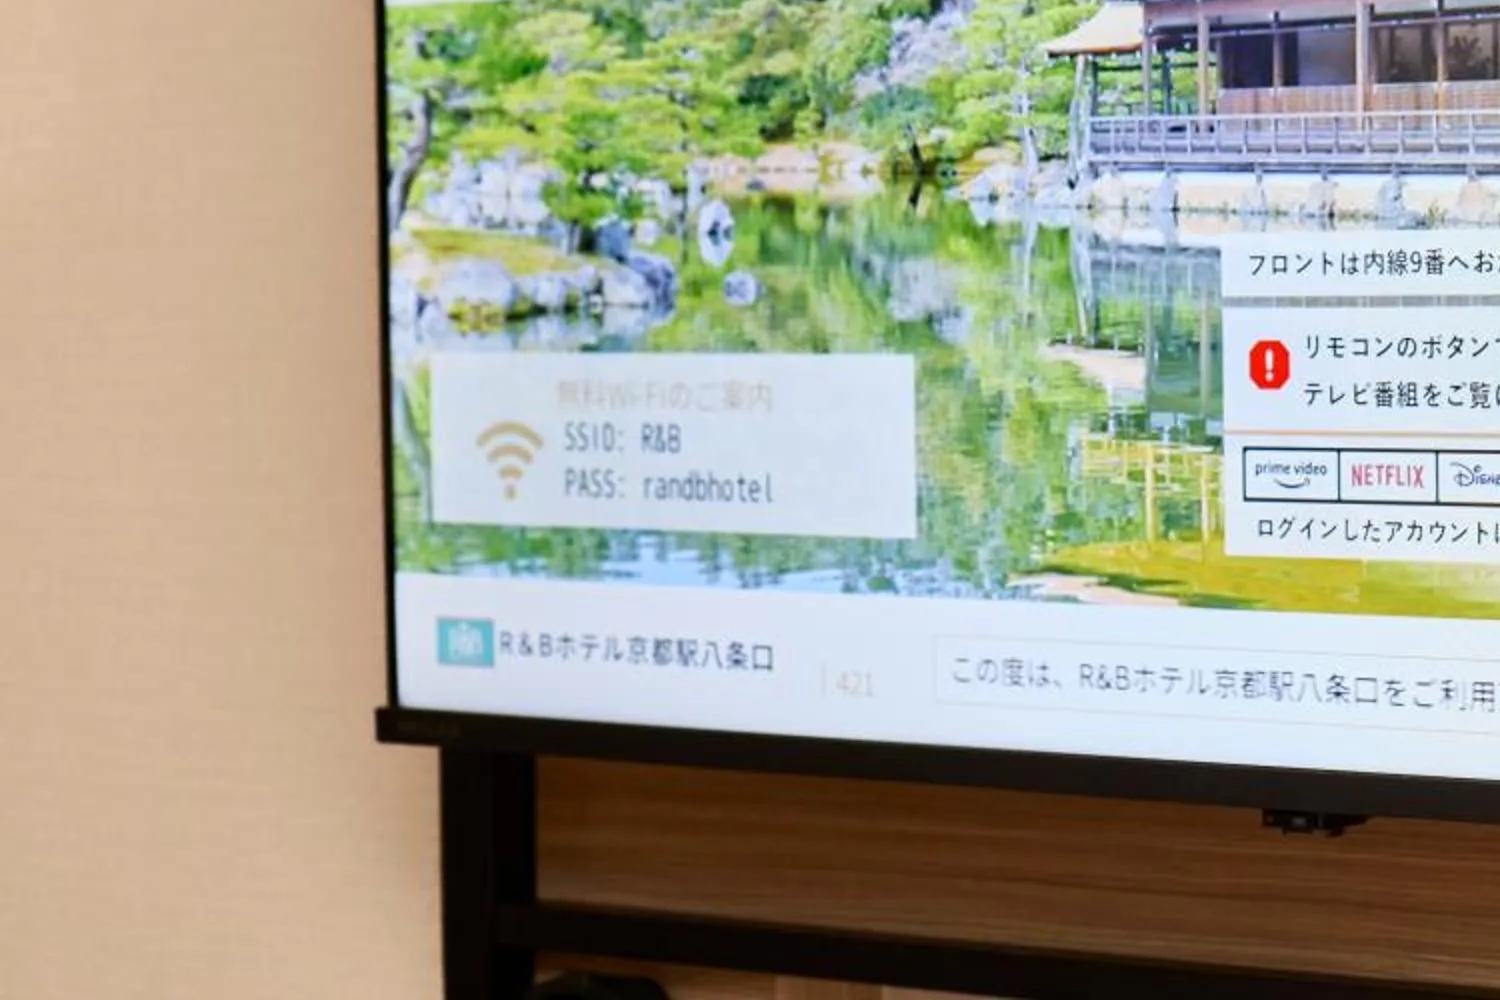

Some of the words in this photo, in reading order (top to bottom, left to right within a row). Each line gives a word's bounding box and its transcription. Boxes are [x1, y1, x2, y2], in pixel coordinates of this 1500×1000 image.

[564, 422, 624, 452] SSID:
[641, 424, 681, 453] R&B
[1255, 463, 1292, 478] prime
[1294, 461, 1327, 477] video
[1351, 465, 1424, 489] NETFLIX
[564, 469, 625, 499] PASS:
[643, 473, 773, 503] randbhotel
[501, 632, 773, 672] R&Bホテル京都駅八条口
